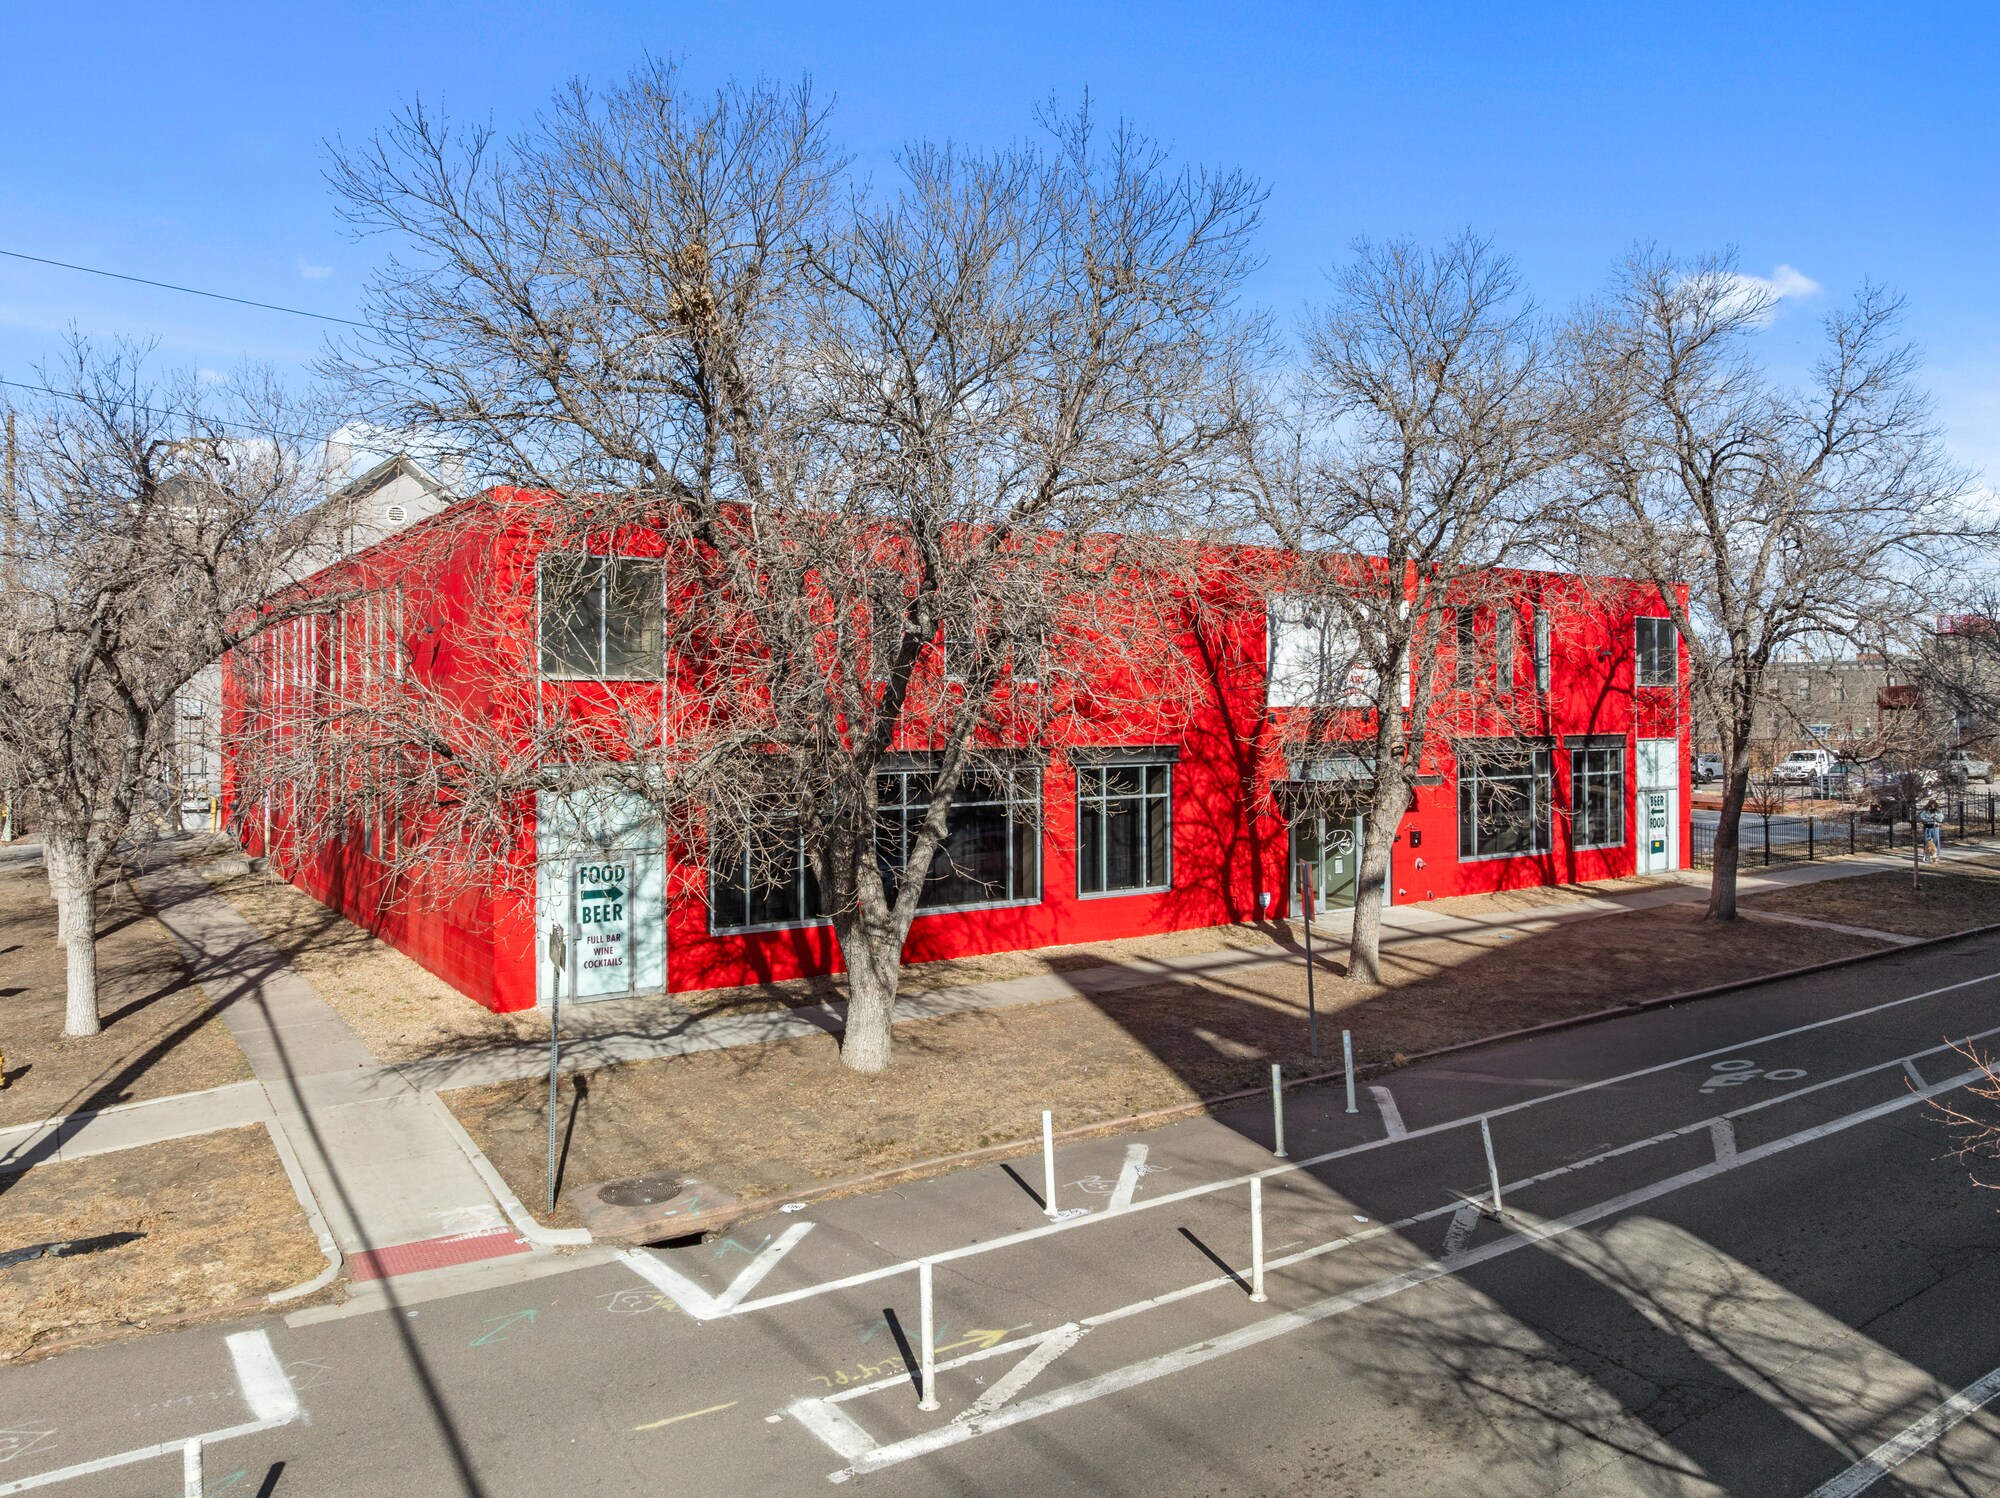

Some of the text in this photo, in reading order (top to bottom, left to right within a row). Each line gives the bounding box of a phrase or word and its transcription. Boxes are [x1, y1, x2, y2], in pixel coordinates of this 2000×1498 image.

[1650, 795, 1664, 807] BEER
[1650, 817, 1665, 829] FOOD
[580, 865, 625, 885] FOOD
[582, 904, 623, 924] BEER
[587, 933, 621, 945] FULL BAR
[593, 946, 614, 956] WINE
[583, 957, 623, 969] COCKTAILS
